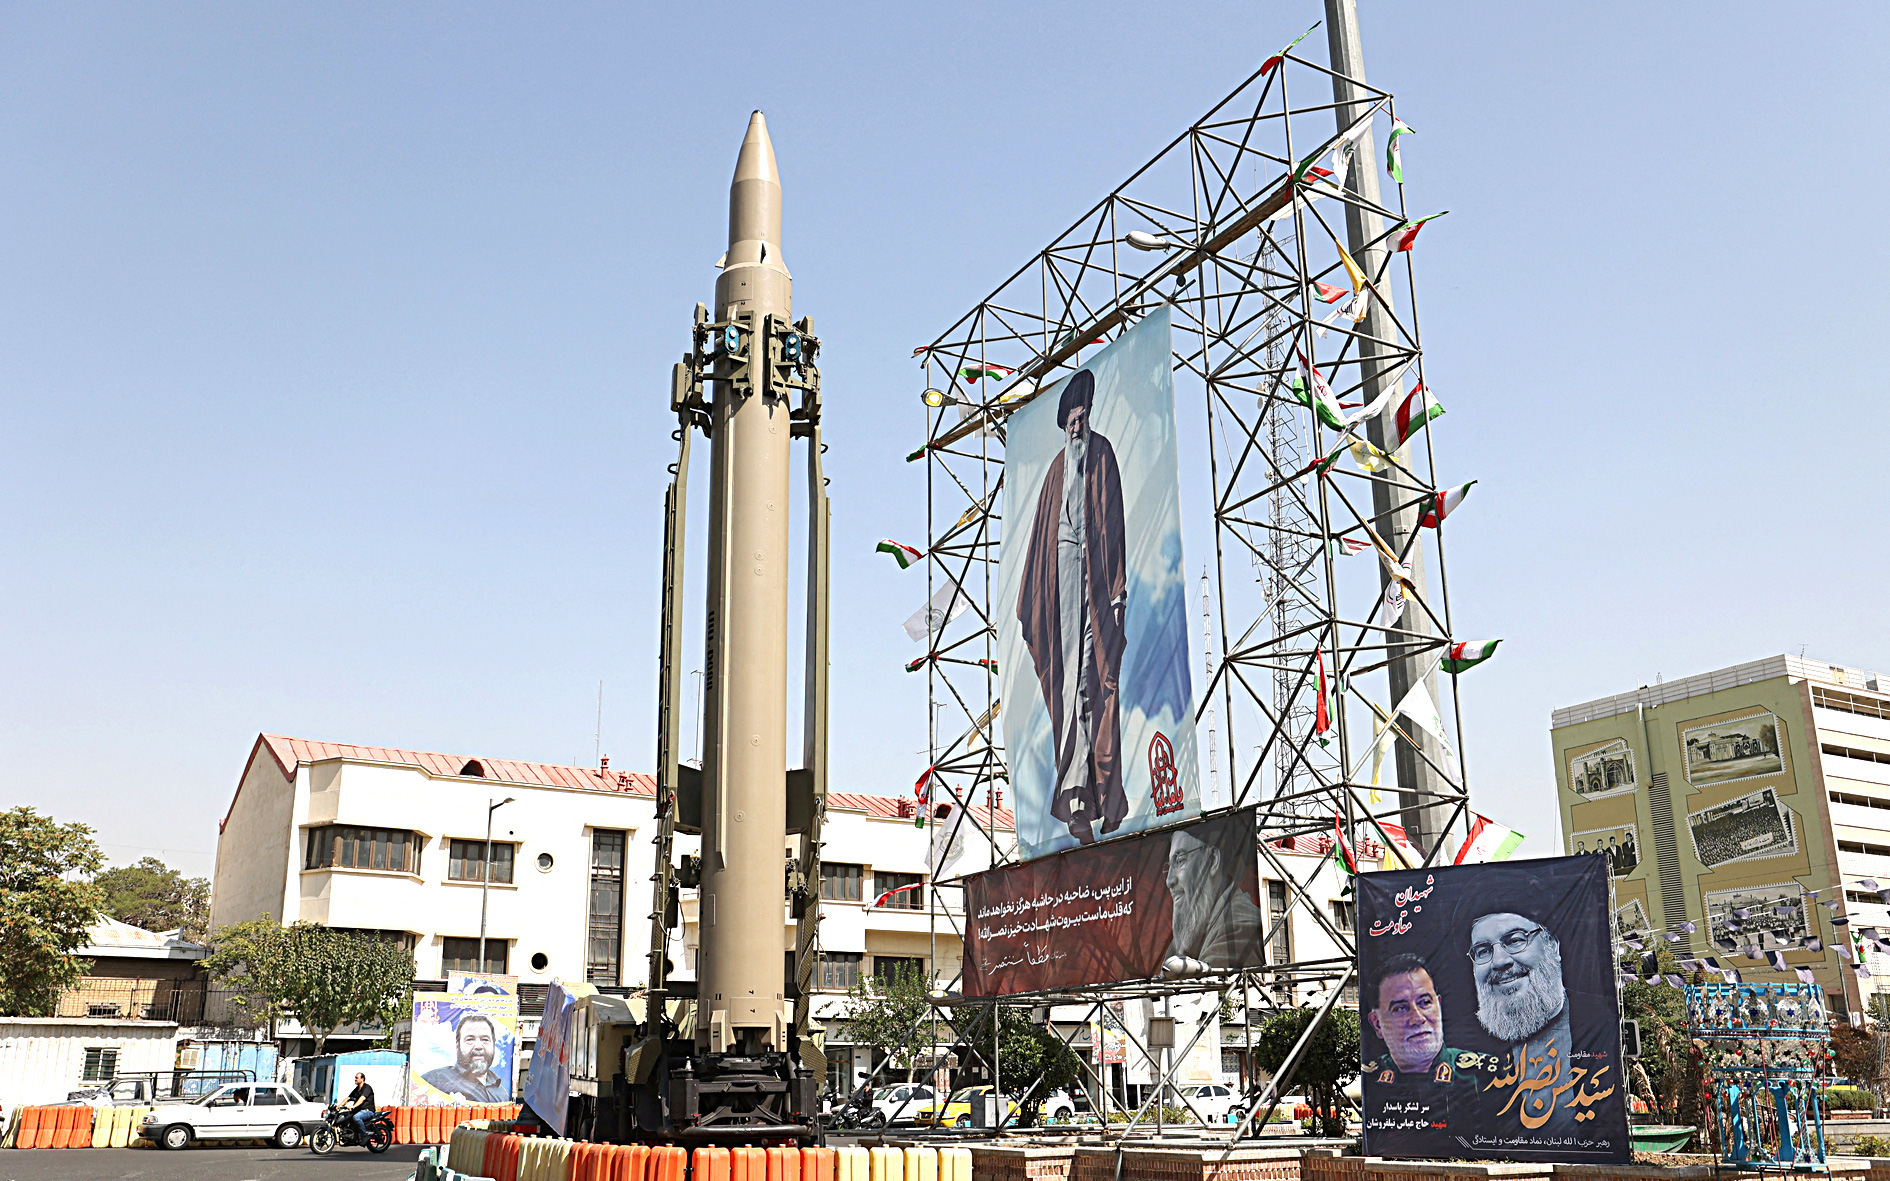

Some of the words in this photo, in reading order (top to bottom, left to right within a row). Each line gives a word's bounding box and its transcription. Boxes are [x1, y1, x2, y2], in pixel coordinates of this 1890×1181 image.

[1111, 878, 1125, 898] این
[1124, 876, 1132, 895] از
[1053, 893, 1064, 907] در
[1064, 885, 1090, 905] ضاحیه
[1395, 874, 1435, 913] شهیدان
[1014, 897, 1031, 915] هرگز
[1032, 893, 1054, 911] حاشیه
[1124, 901, 1134, 915] که
[978, 905, 991, 919] ماند
[991, 901, 1015, 918] نخواهد
[1108, 902, 1123, 922] قلب
[1056, 915, 1082, 929] بیروت
[1369, 910, 1412, 936] مقاومت
[1566, 1050, 1591, 1060] مقاومت
[1591, 1051, 1608, 1060] شهید
[1382, 1101, 1403, 1114] پاسدار
[1366, 1117, 1396, 1130] نیلفروشان
[1396, 1118, 1415, 1130] عباس
[1415, 1118, 1430, 1130] حاج
[1430, 1119, 1447, 1130] شهید
[1472, 1134, 1498, 1146] ایستادگی
[1503, 1136, 1529, 1146] مقاومت
[1577, 1138, 1594, 1148] حزب
[1595, 1139, 1611, 1148] رهبر
